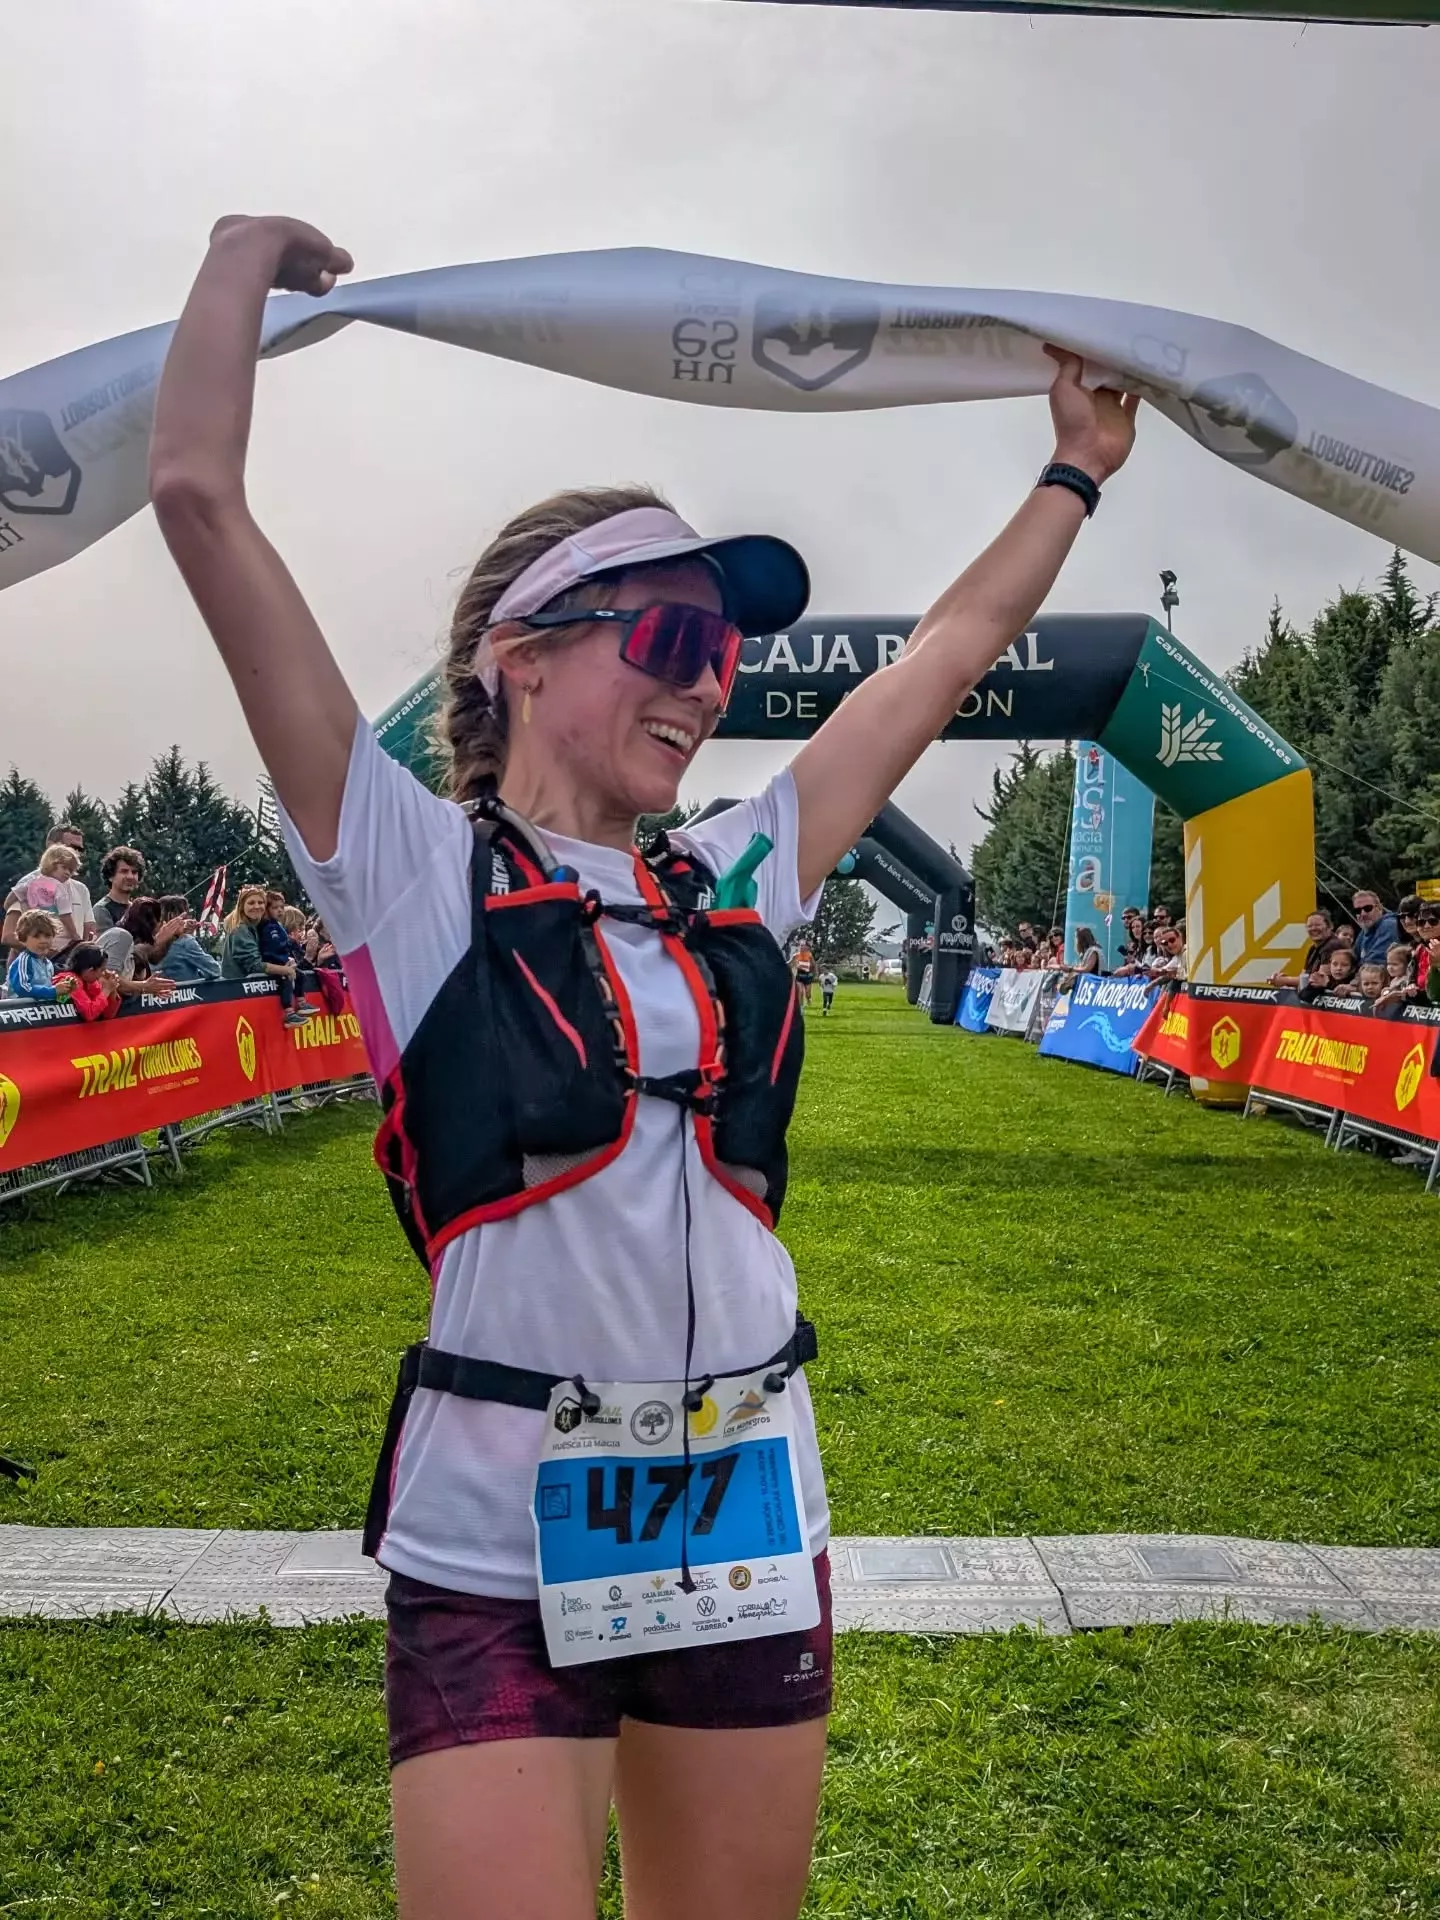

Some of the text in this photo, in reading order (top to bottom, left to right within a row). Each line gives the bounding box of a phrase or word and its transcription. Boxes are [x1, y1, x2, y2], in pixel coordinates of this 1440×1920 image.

[738, 632, 1055, 673] CAJA RAL
[766, 691, 818, 719] DE
[1155, 635, 1292, 765] cajaruraldearagon.es
[1074, 977, 1091, 1007] Los
[1195, 985, 1280, 1002] FIREHAWK
[1312, 995, 1364, 1013] FIREHAWK
[71, 1037, 203, 1099] TRAIL TORROLLONES
[1275, 1030, 1369, 1075] TRAIL TORROLLONES
[586, 1452, 741, 1545] 477
[696, 1622, 728, 1632] CABRERO
